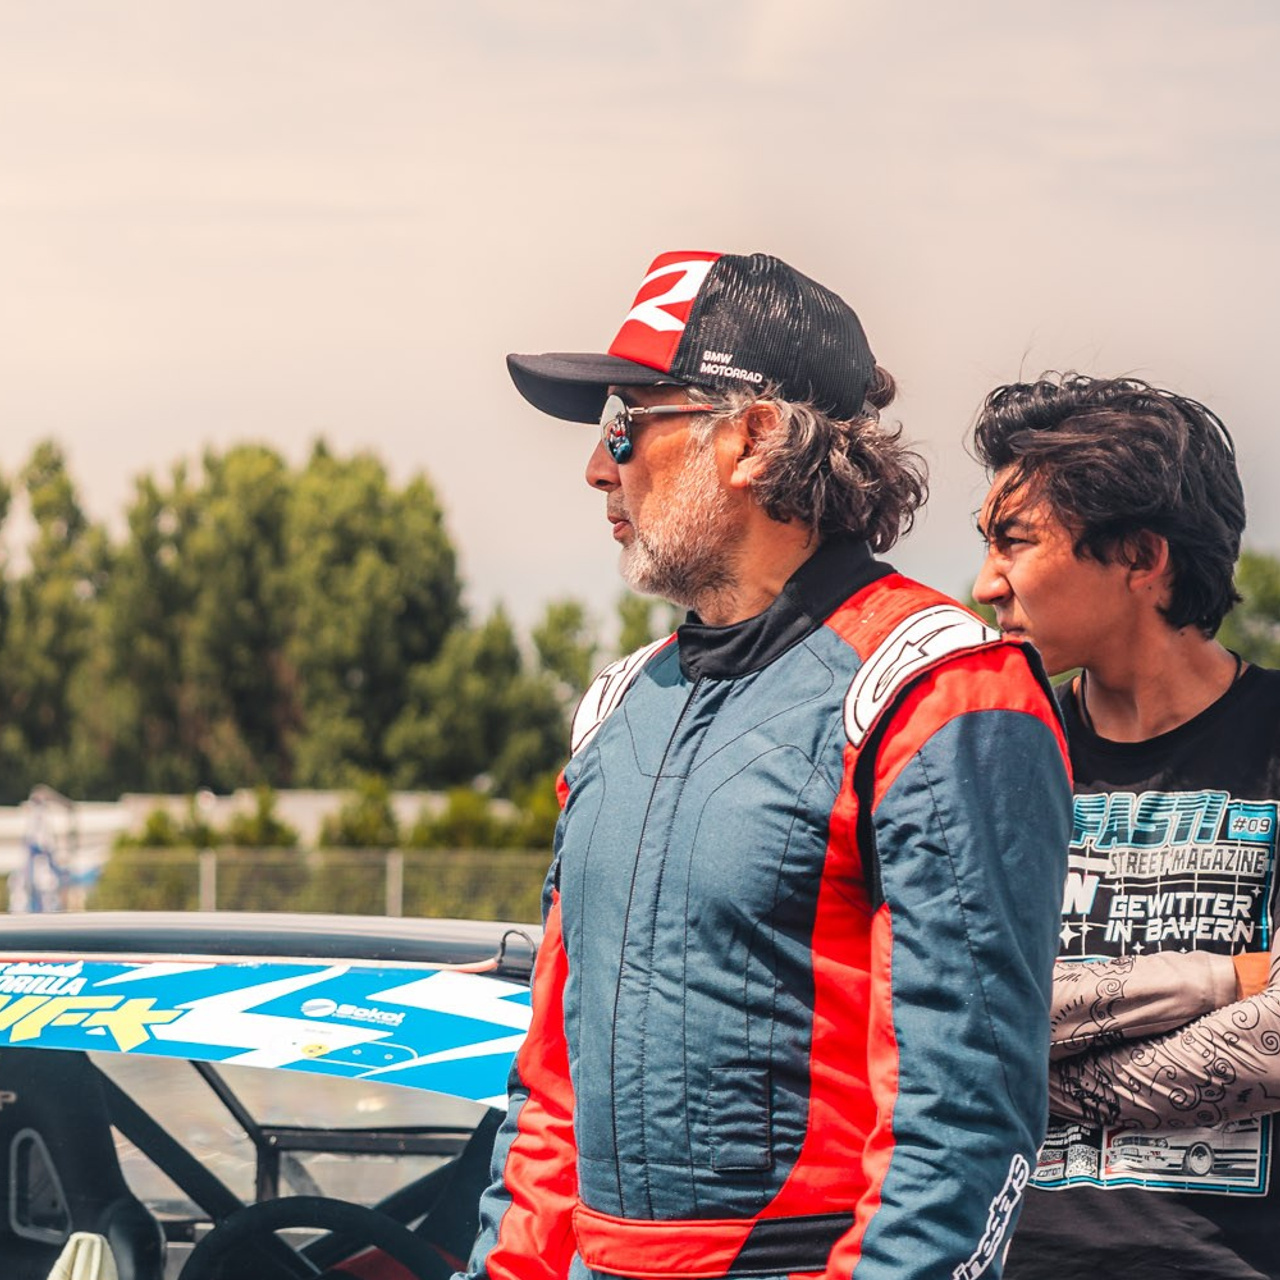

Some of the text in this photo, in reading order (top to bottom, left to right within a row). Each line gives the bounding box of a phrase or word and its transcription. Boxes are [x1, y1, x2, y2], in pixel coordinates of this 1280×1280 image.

[702, 350, 733, 364] BMW
[699, 362, 763, 384] MOTORRAD
[1231, 816, 1272, 833] #09
[1107, 848, 1267, 876] STREET MAGAZINE
[1108, 891, 1254, 919] GEWITTER
[1104, 918, 1255, 943] IN BAYERN
